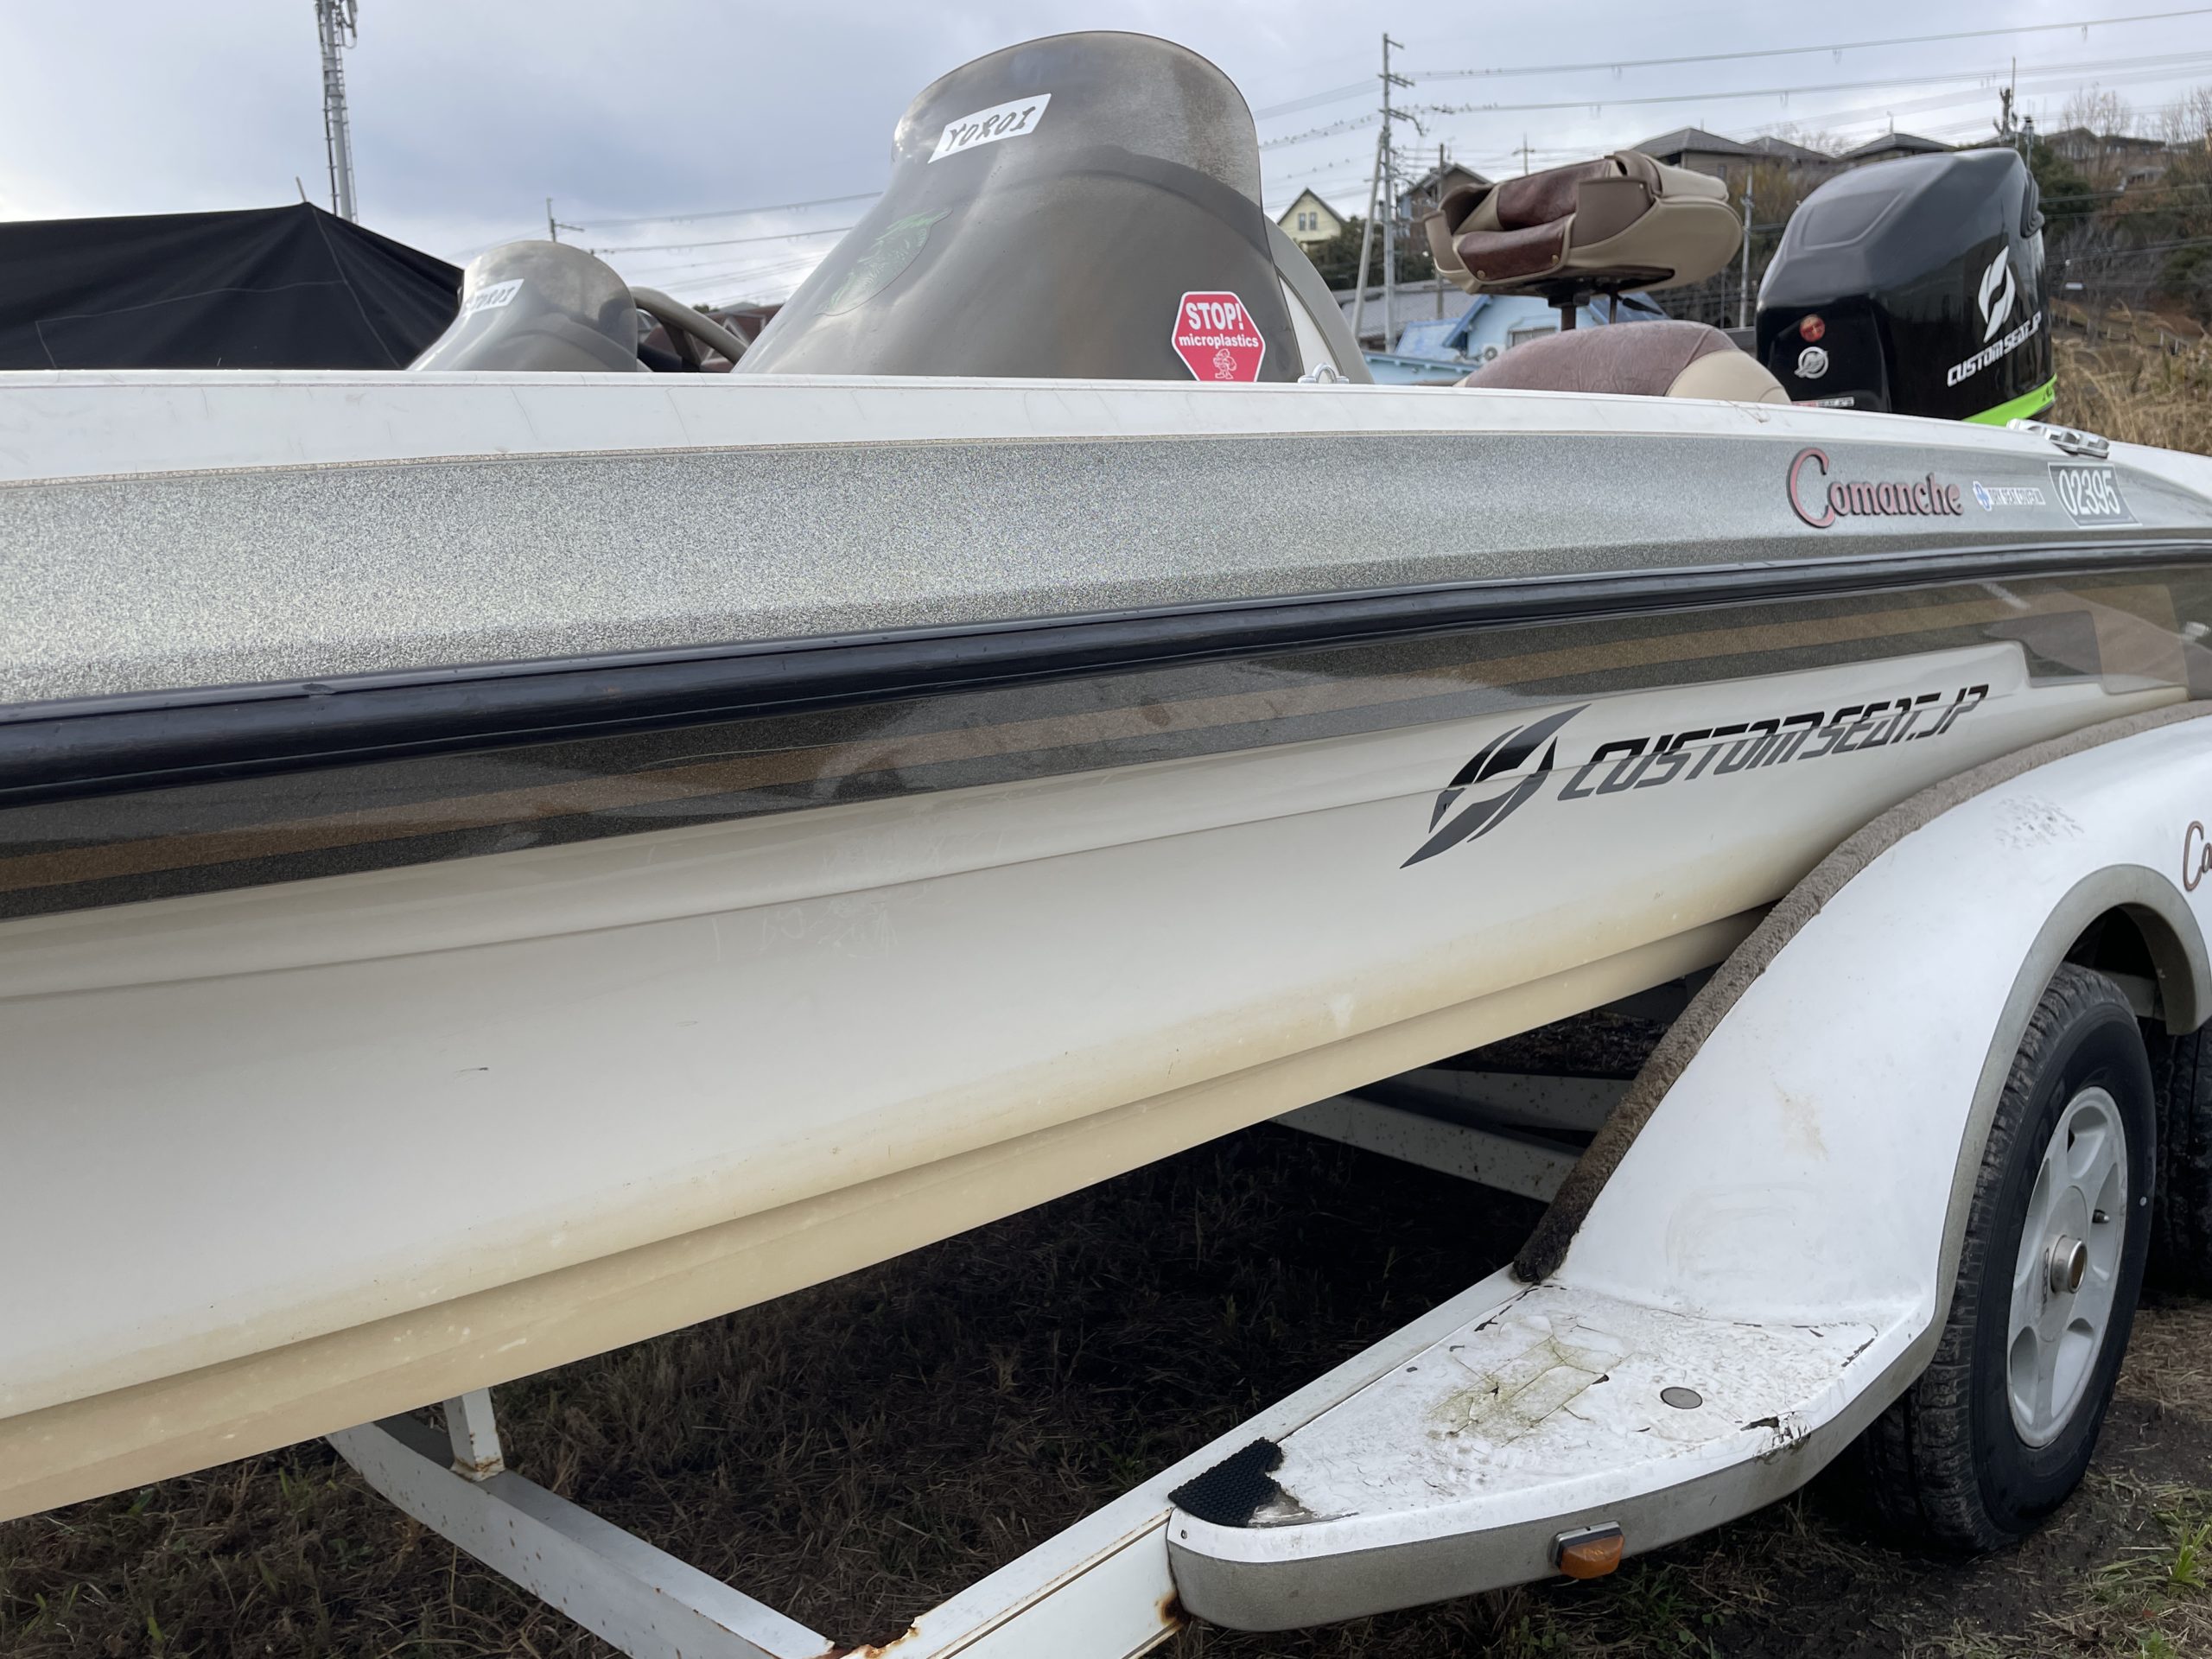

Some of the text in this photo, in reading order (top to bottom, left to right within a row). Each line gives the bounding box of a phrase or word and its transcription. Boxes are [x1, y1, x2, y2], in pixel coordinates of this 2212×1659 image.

[945, 106, 1036, 151] YOROI
[1185, 302, 1244, 330] STOP!
[1178, 334, 1259, 349] microplastics
[1786, 447, 1965, 529] Comanche
[2058, 468, 2121, 517] 02395
